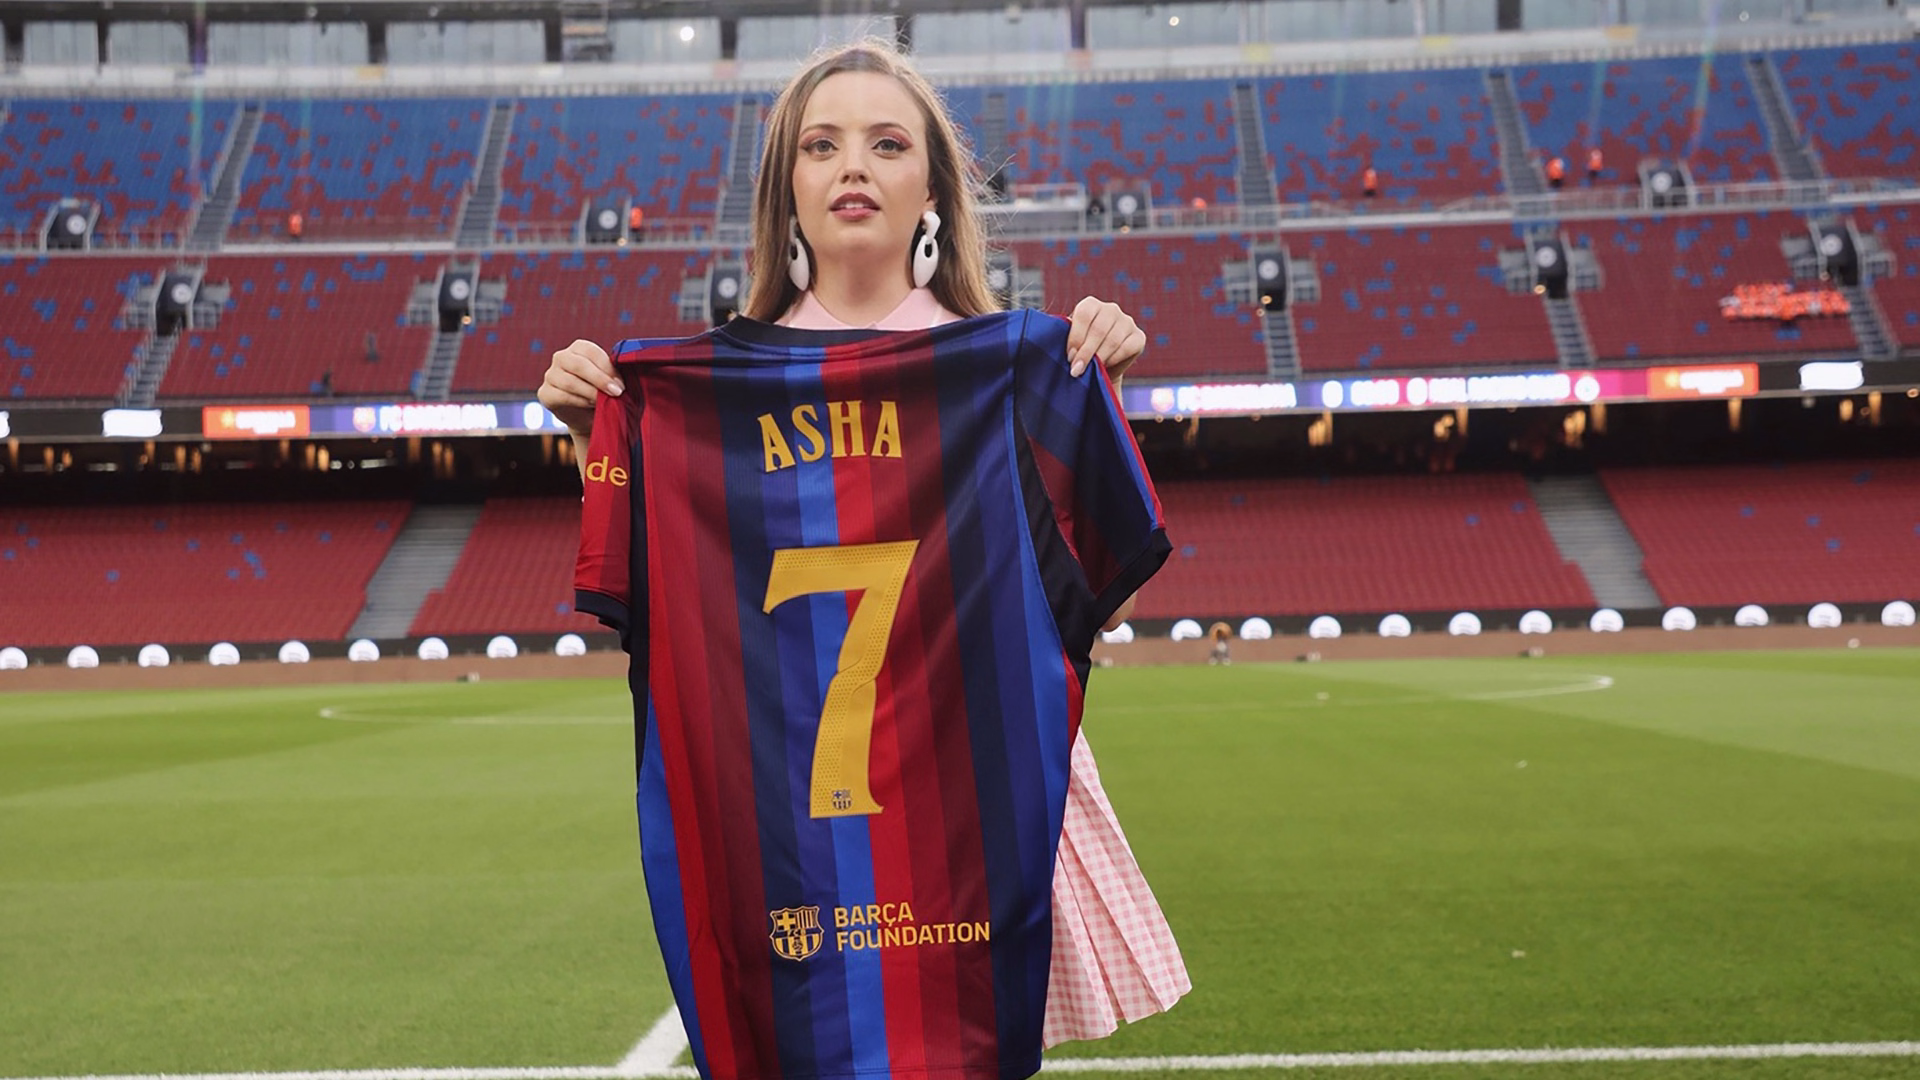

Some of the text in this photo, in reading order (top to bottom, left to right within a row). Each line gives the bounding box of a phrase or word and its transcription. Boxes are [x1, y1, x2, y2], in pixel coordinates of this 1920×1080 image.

[758, 400, 903, 473] ASHA
[586, 455, 628, 487] de
[762, 539, 921, 819] 7
[834, 902, 915, 928] BARÇA
[836, 921, 991, 952] FOUNDATION
